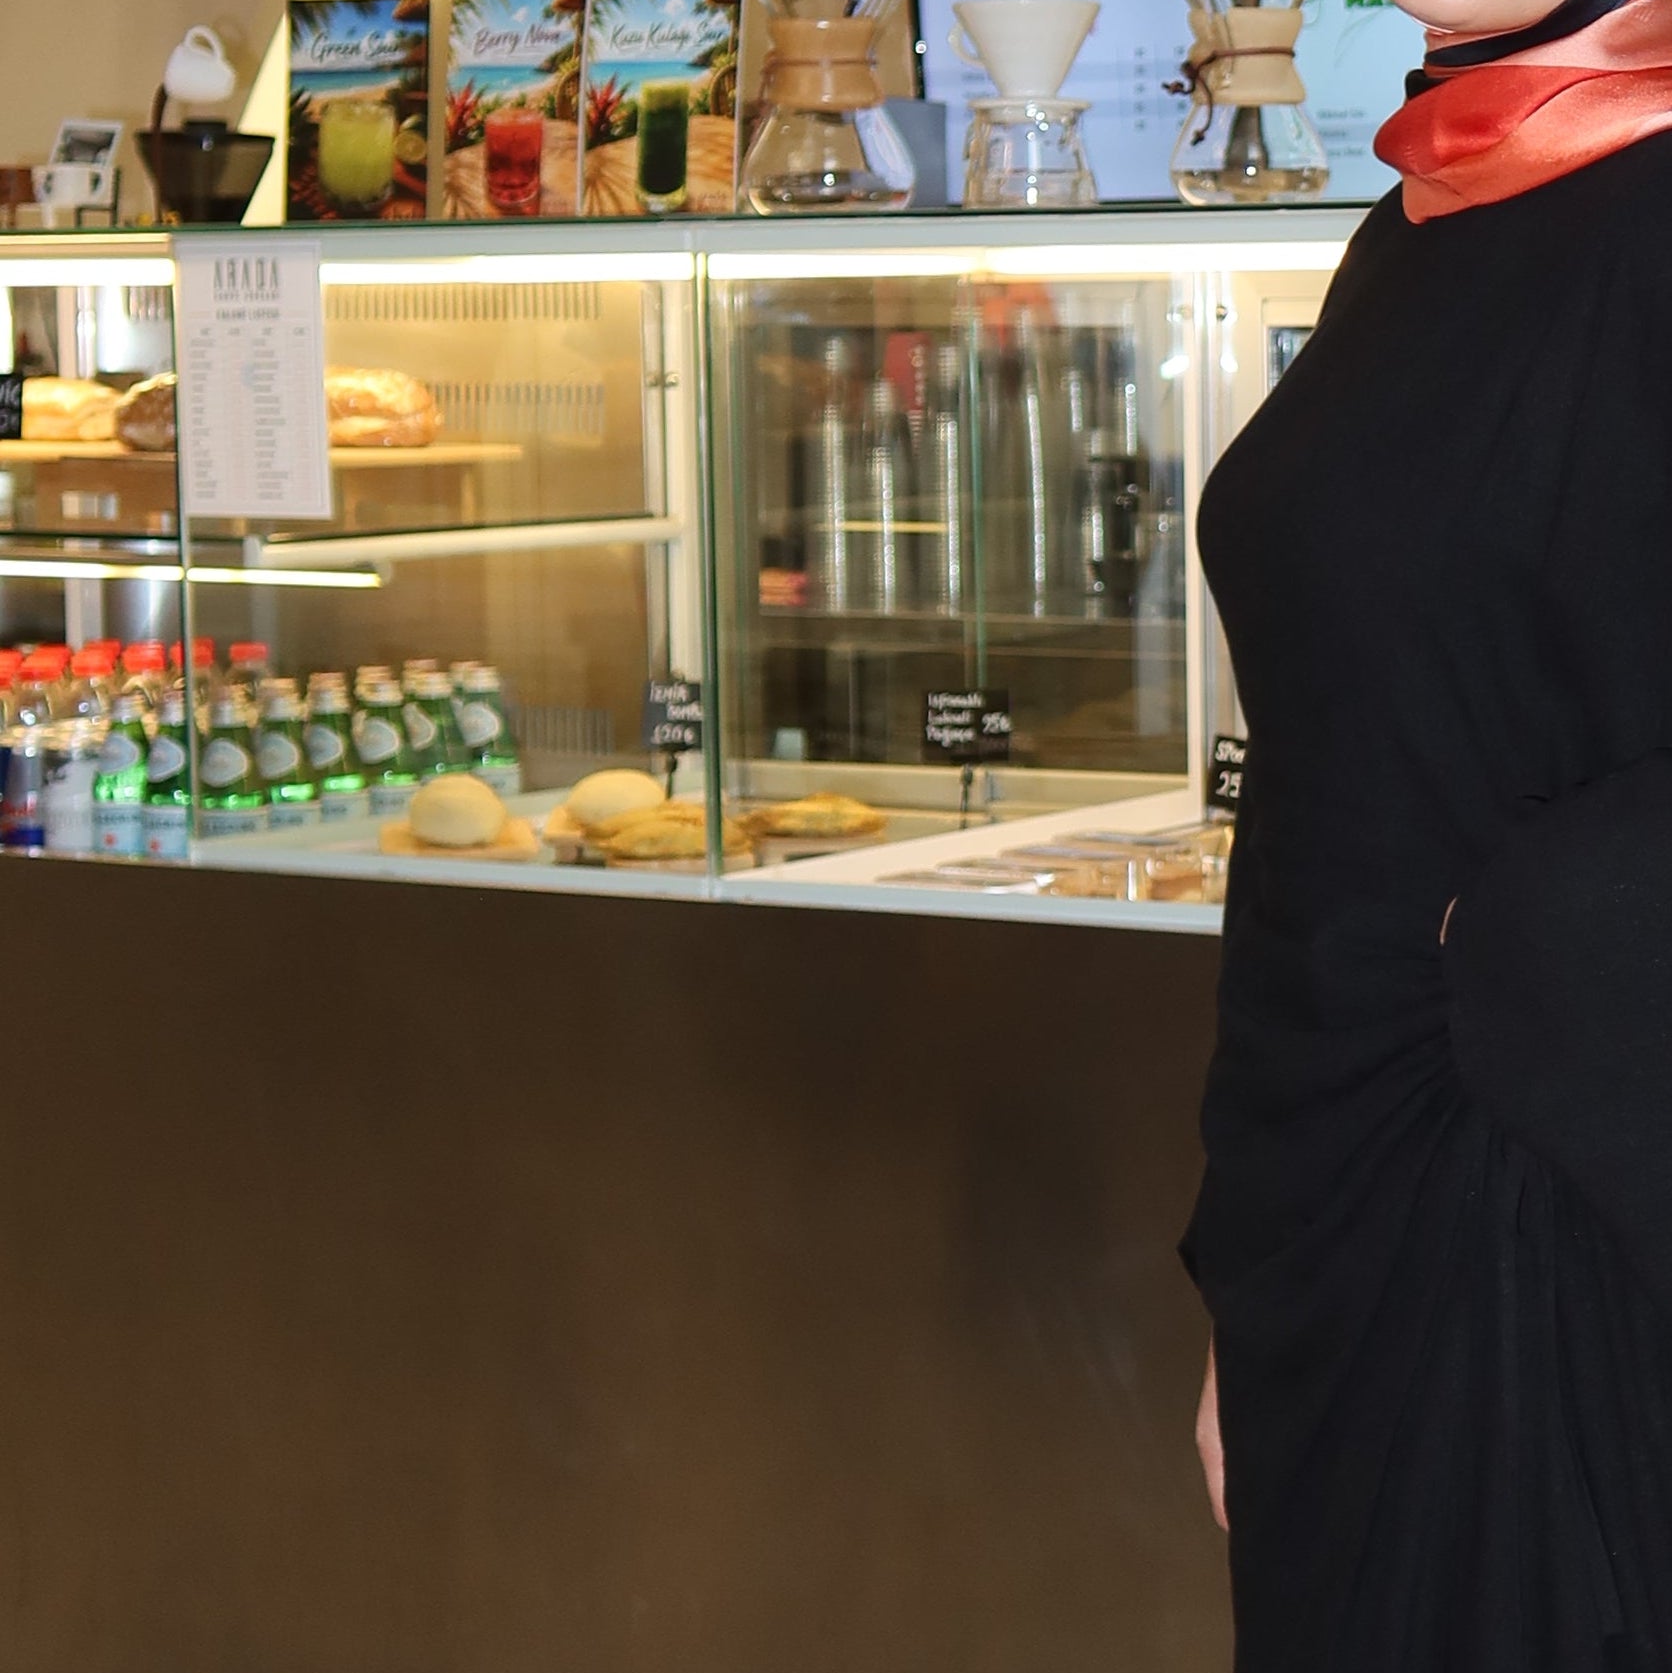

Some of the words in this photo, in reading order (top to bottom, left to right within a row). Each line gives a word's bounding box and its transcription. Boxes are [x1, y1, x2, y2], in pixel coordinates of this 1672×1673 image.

[311, 33, 361, 62] Green
[473, 28, 520, 53] Berry
[213, 256, 280, 289] ARADA
